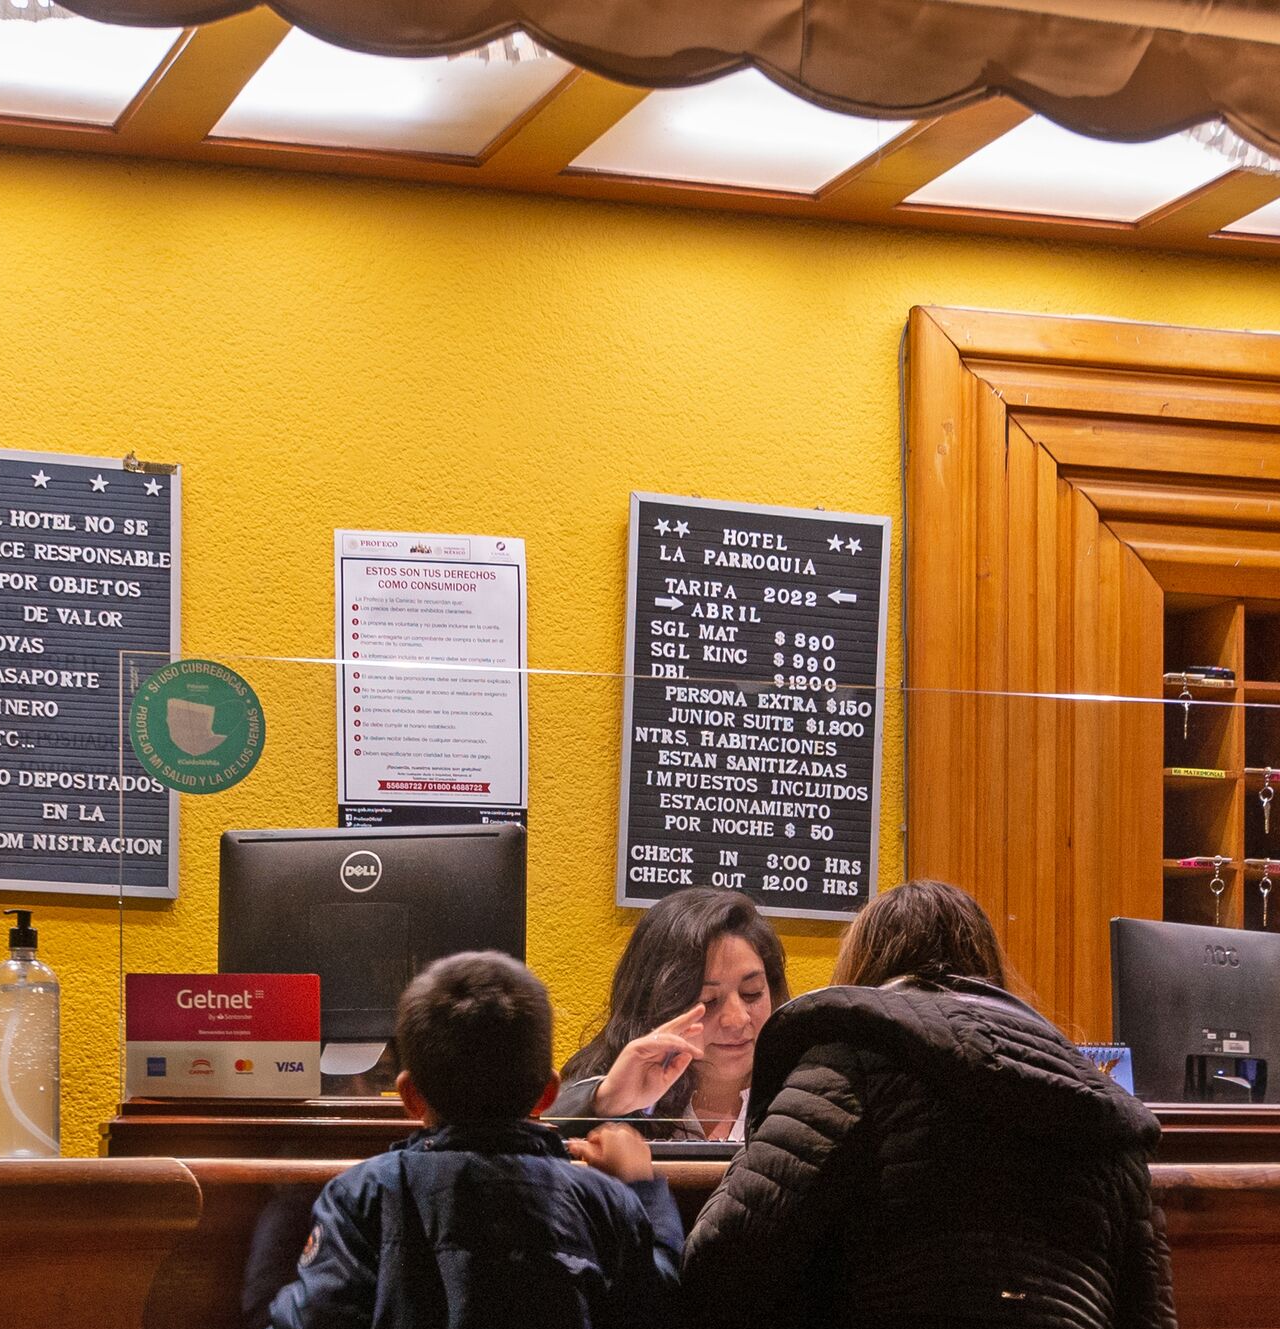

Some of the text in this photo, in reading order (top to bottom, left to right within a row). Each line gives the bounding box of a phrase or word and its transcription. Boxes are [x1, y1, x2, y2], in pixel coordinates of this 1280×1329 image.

[10, 510, 76, 530] HOTEL
[85, 516, 114, 533] NO
[124, 519, 148, 536] SE
[360, 540, 398, 548] PROFECO
[723, 529, 787, 550] HOTEL
[34, 544, 171, 569] RESPONSABLE
[660, 545, 816, 575] LA PARROQUIA
[366, 566, 496, 580] ESTOS SON TUS DERECHOS
[378, 580, 477, 592] COMO CONSUMIDOR
[50, 576, 141, 597] OBJETOS
[665, 578, 816, 606] TARIFA 2022
[24, 606, 122, 627] DE VALOR
[691, 603, 760, 622] ABRIL
[651, 620, 834, 651] SGL MAT $ 890
[651, 642, 689, 659] SGL
[774, 653, 784, 667] $
[793, 654, 835, 672] 990
[159, 667, 179, 683] USO
[181, 663, 247, 696] CUBREBOCAS
[651, 664, 836, 692] DBL $1200
[666, 686, 871, 717] PERSONA EXTRA $150
[668, 708, 864, 737] JUNIOR SUITE $1.800
[136, 705, 258, 786] PROTEJO MI SALUD Y LA DE LOS DEMÁS
[636, 727, 837, 756] NTRS. HABITACIONES
[659, 750, 847, 778] ESTAN SANITIZADAS
[19, 771, 164, 792] DEPOSITADOS
[647, 771, 868, 801] IMPUESTOS INCLUIDOS
[43, 803, 105, 821] EN LA
[660, 793, 830, 819] ESTACIONAMIENTO
[665, 815, 833, 840] POR NOCHE $ 50
[345, 865, 377, 876] DELL
[631, 845, 861, 875] CHECK IN 3:00 HRS
[630, 867, 692, 884] CHECK
[712, 872, 745, 888] OUT
[823, 879, 858, 895] HRS
[176, 989, 253, 1009] Getnet
[275, 1062, 304, 1072] VISA
